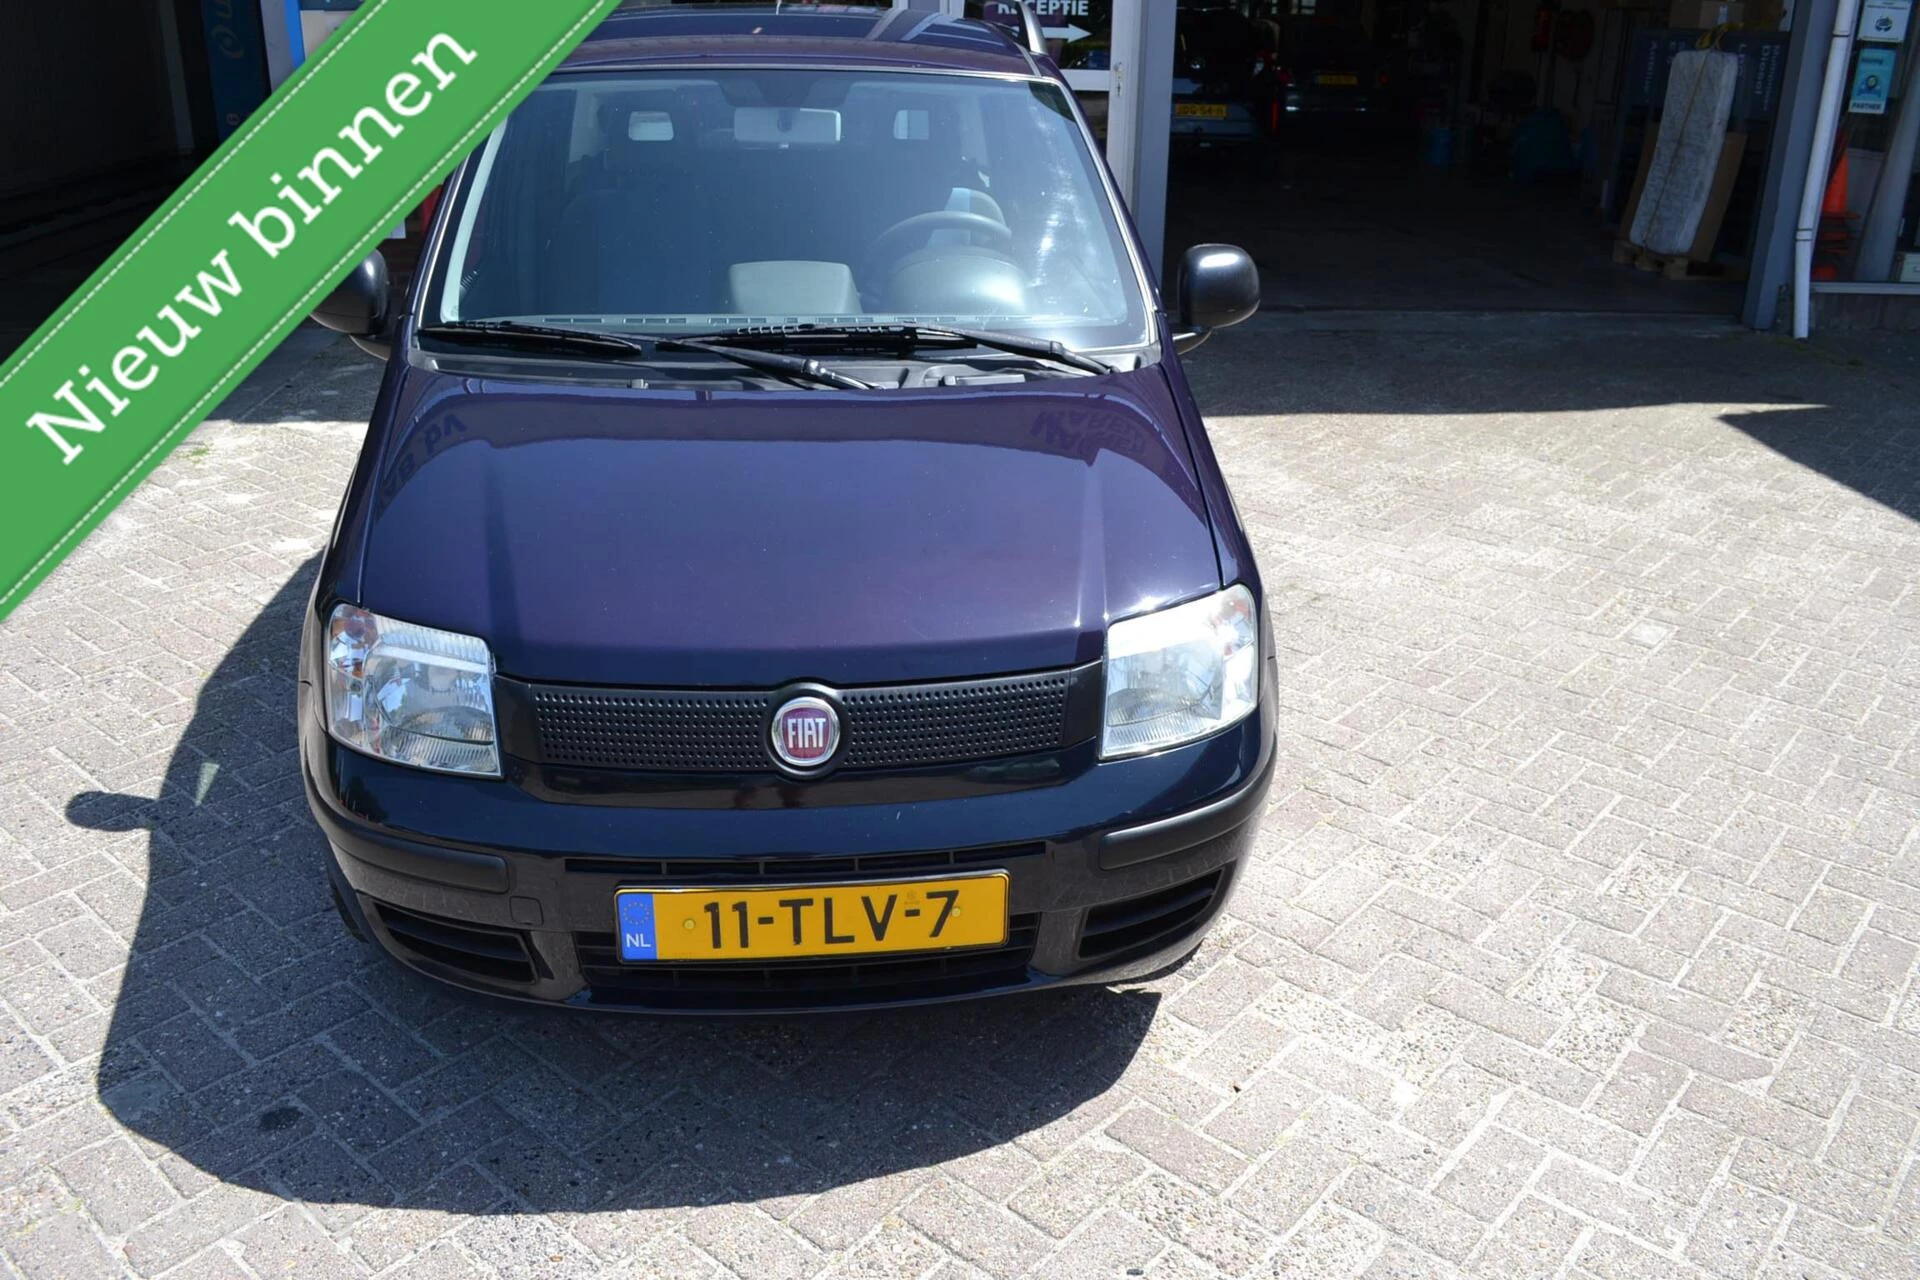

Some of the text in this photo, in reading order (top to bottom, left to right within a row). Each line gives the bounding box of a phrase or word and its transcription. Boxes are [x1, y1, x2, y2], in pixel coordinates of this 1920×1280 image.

[998, 0, 1089, 16] REPTIE
[787, 717, 826, 749] FIAT
[625, 889, 961, 950] NL 11-TLV-7
